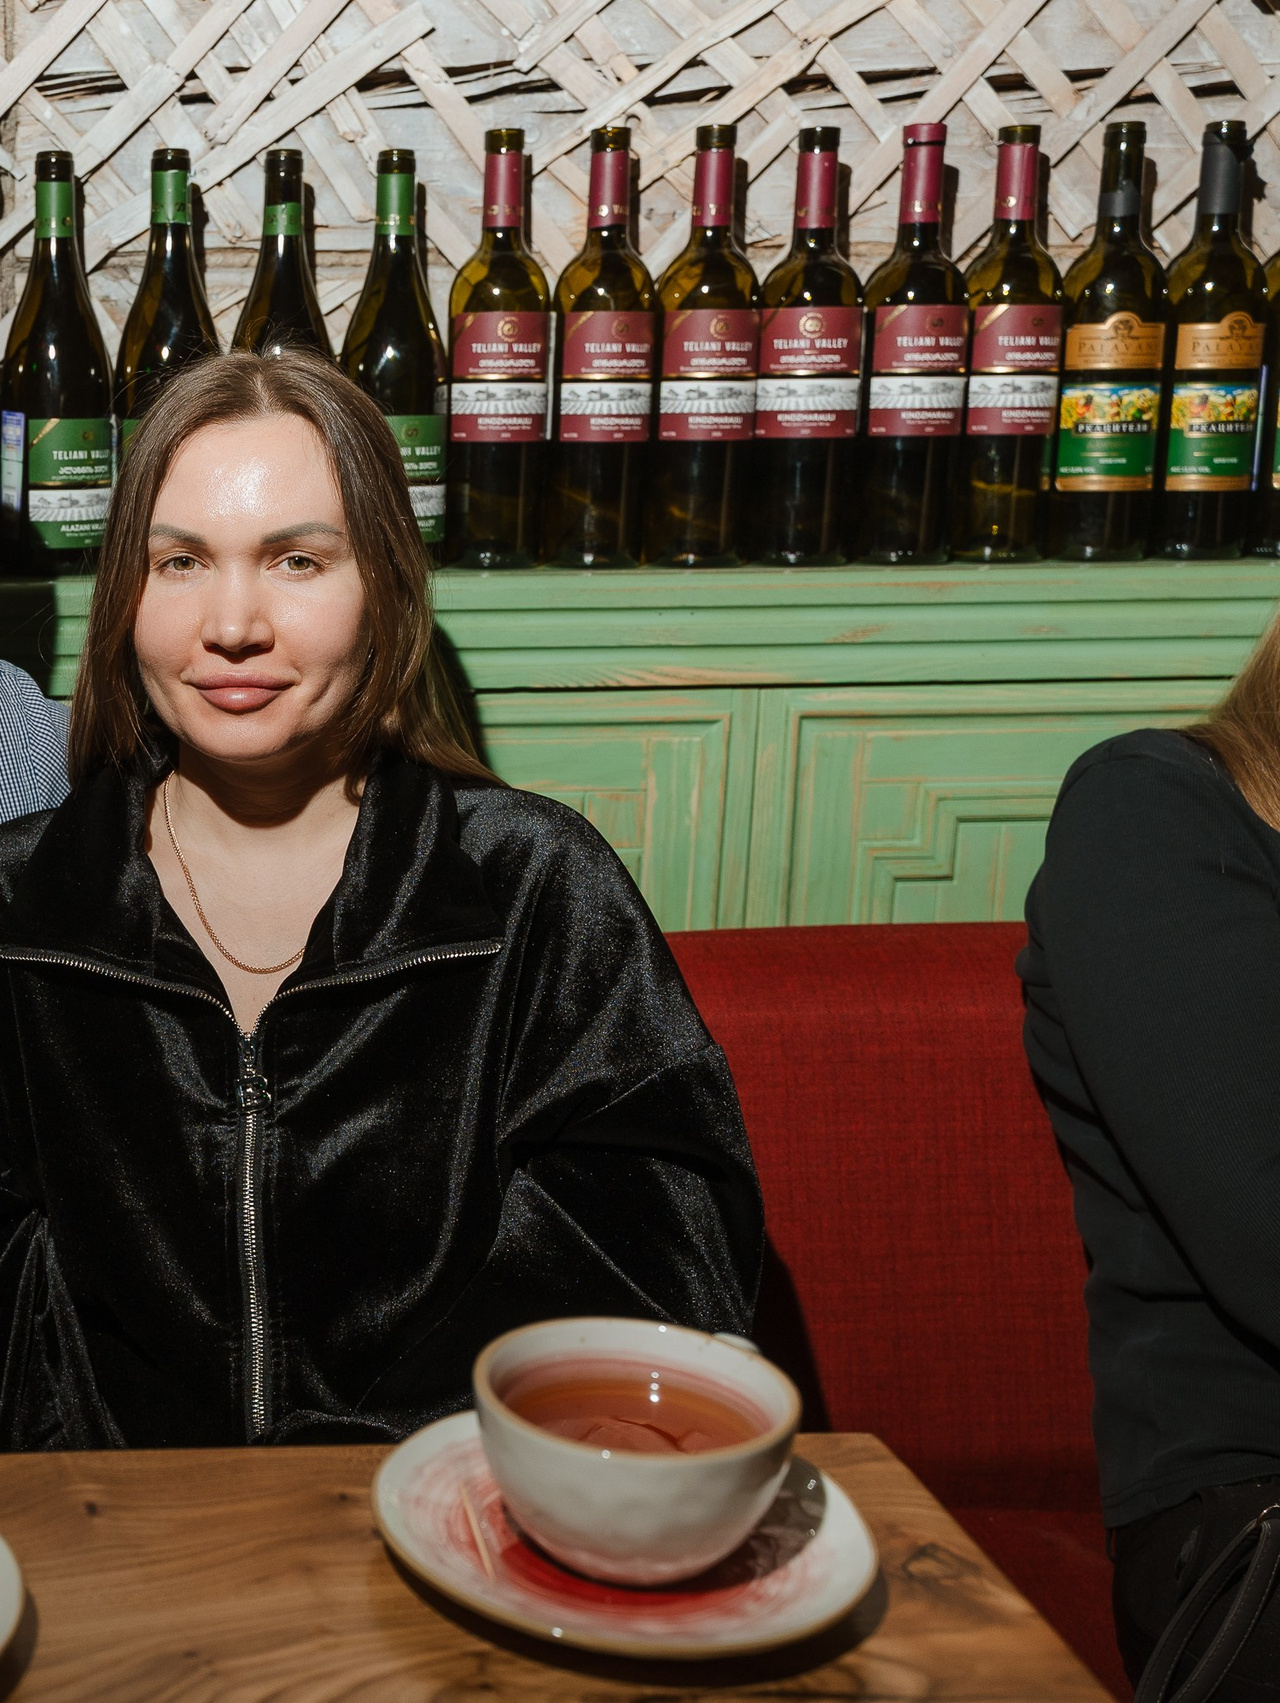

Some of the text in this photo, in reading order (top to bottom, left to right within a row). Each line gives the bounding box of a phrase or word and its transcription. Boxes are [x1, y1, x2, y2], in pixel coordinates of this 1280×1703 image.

[683, 341, 722, 352] TELIANI
[773, 338, 849, 349] TELIANI VALLEY
[896, 336, 936, 347] TELIANI
[997, 336, 1036, 347] TELIANI
[471, 342, 542, 353] TELIANI VALLEY
[584, 342, 623, 353] TELIANI
[52, 450, 88, 460] TELIANI
